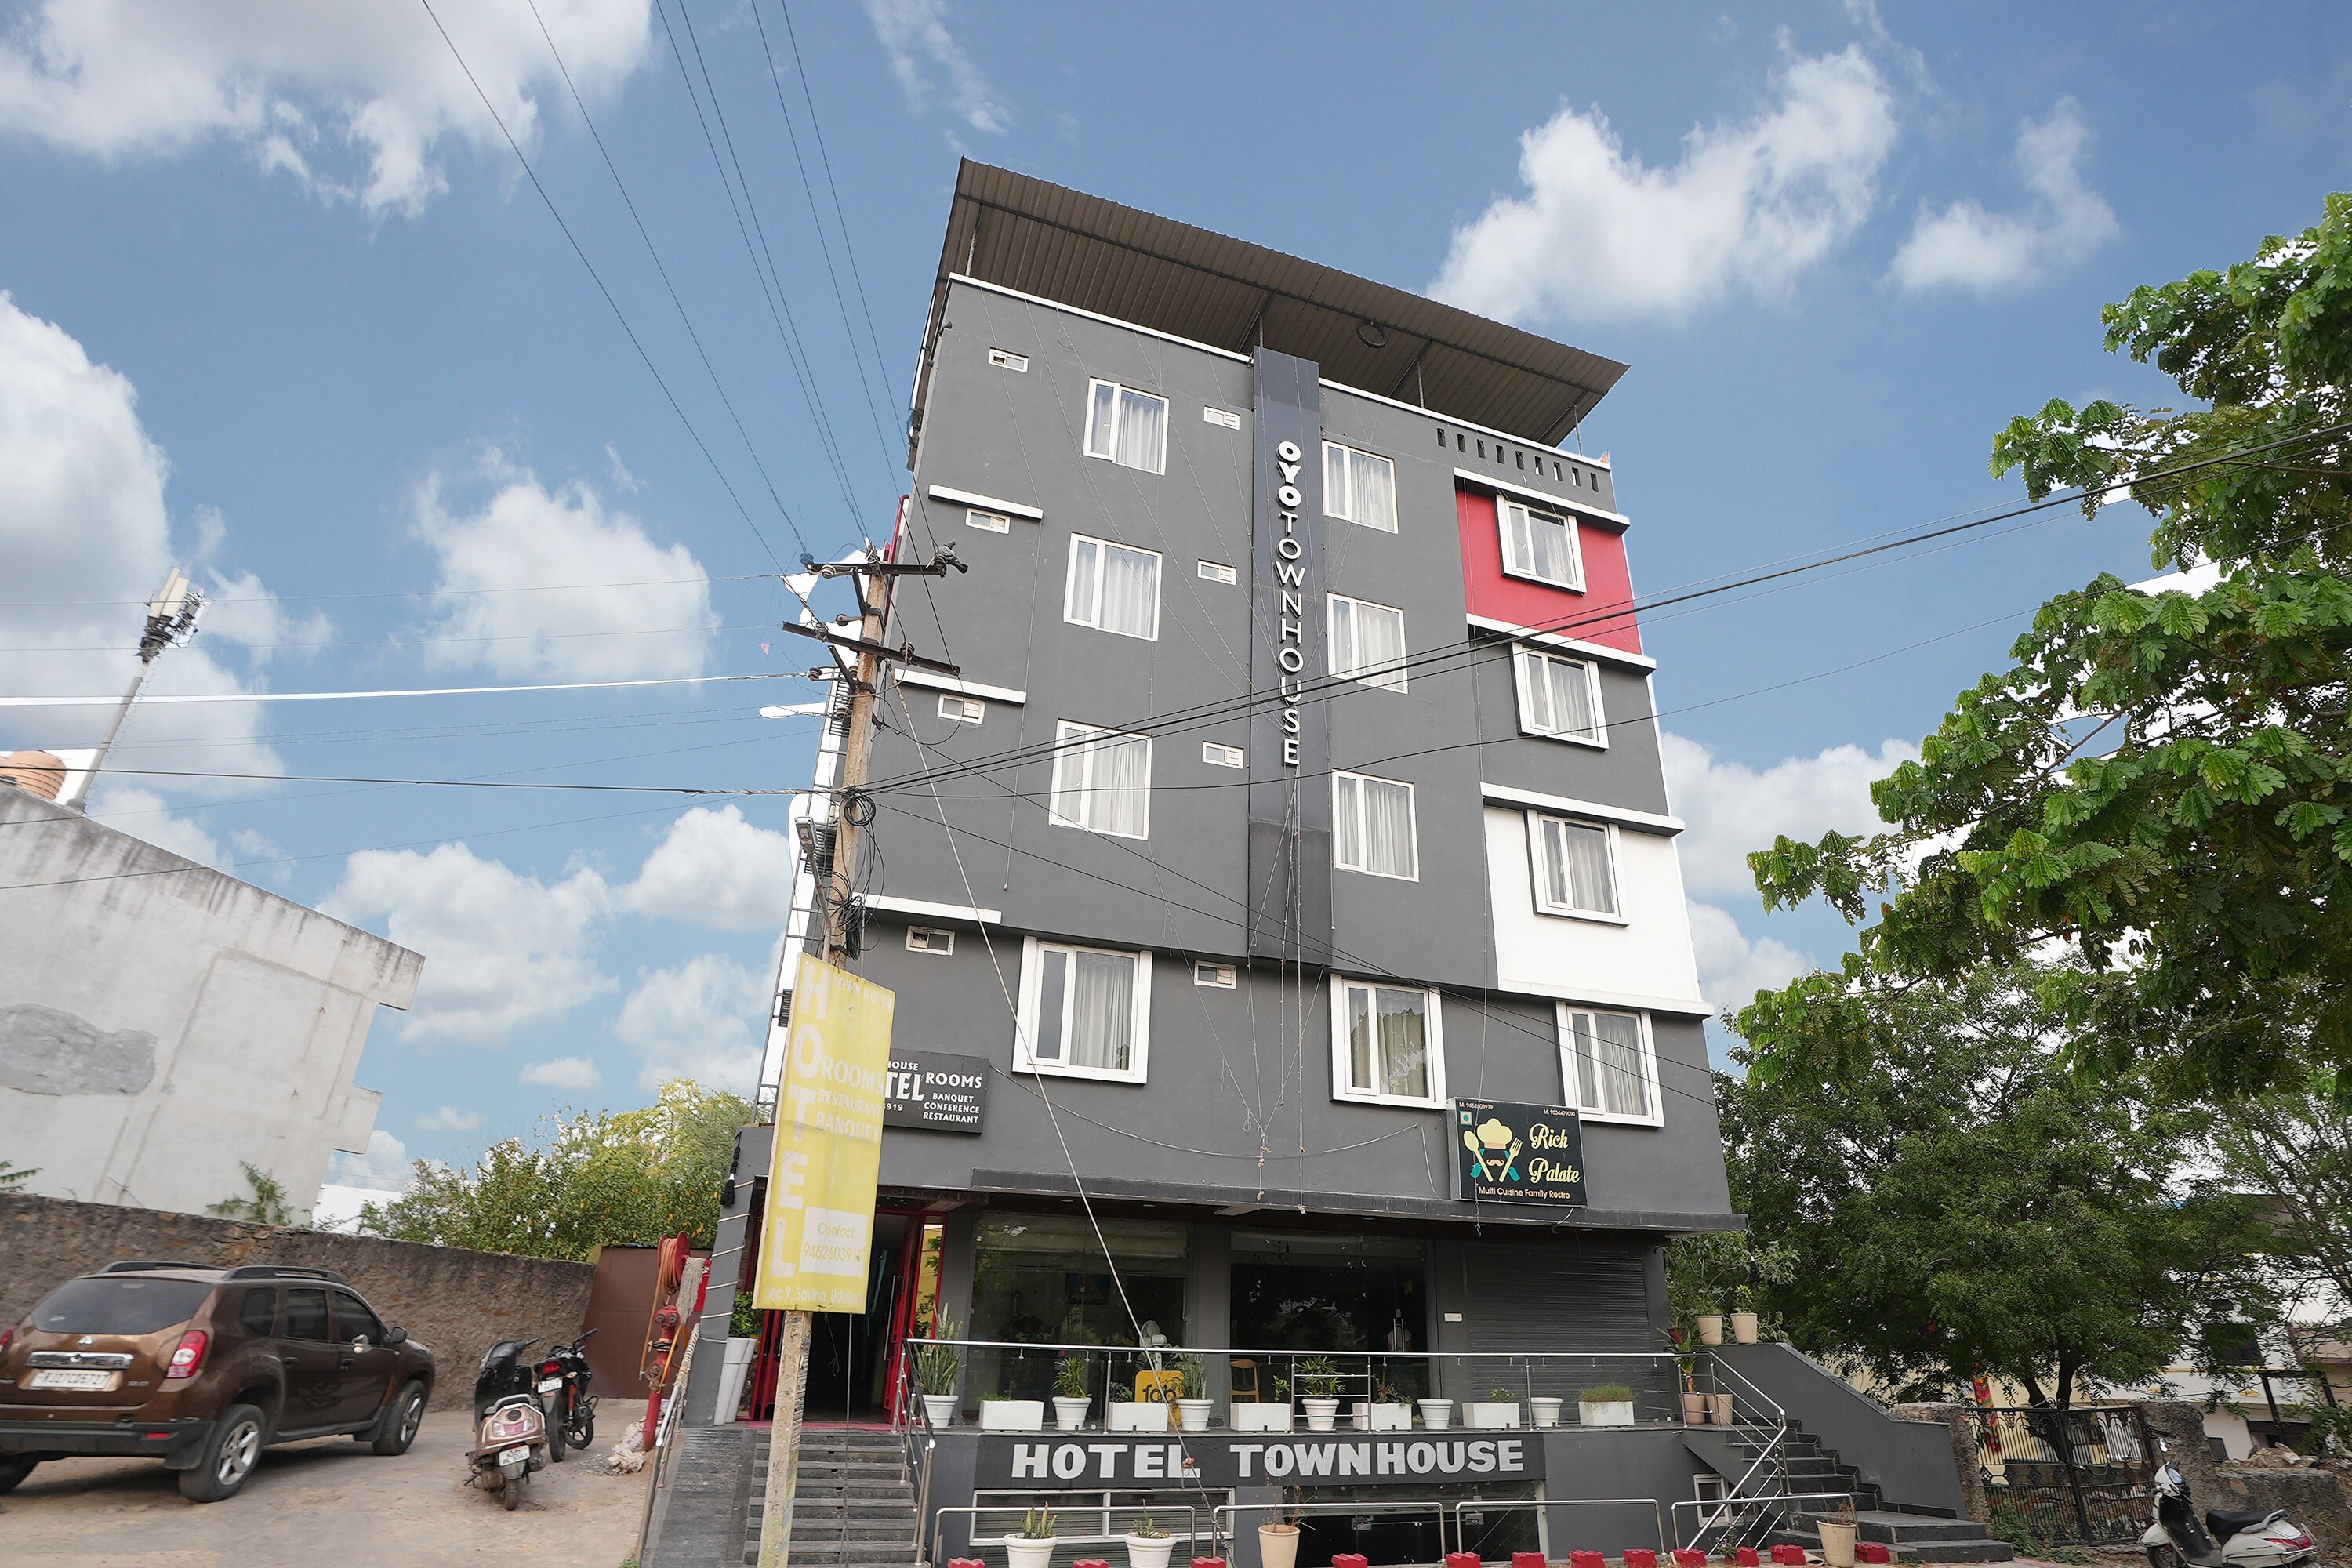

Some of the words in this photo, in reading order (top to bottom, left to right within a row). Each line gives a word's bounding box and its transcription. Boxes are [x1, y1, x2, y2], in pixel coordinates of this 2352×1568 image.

[1276, 440, 1301, 509] OYO
[1274, 510, 1306, 766] TOWNHOUSE
[863, 986, 893, 1011] HOE
[821, 1054, 885, 1096] ROOMS
[925, 1071, 982, 1089] ROOMS
[818, 1087, 883, 1118] RESTAURANT
[924, 1102, 980, 1114] CONFERENCE
[932, 1092, 975, 1104] BANQUET
[770, 961, 831, 1279] HOTEL
[816, 1110, 880, 1144] BANQUET
[923, 1112, 979, 1124] RESTAURANT
[1529, 1123, 1569, 1150] Rich
[1529, 1157, 1581, 1184] Palate
[1478, 1186, 1496, 1195] Multi
[1497, 1187, 1523, 1196] Cuisine
[1525, 1189, 1548, 1200] Family
[1548, 1190, 1571, 1200] Restro
[818, 1222, 855, 1239] Contact
[1011, 1443, 1200, 1479] HOTEL
